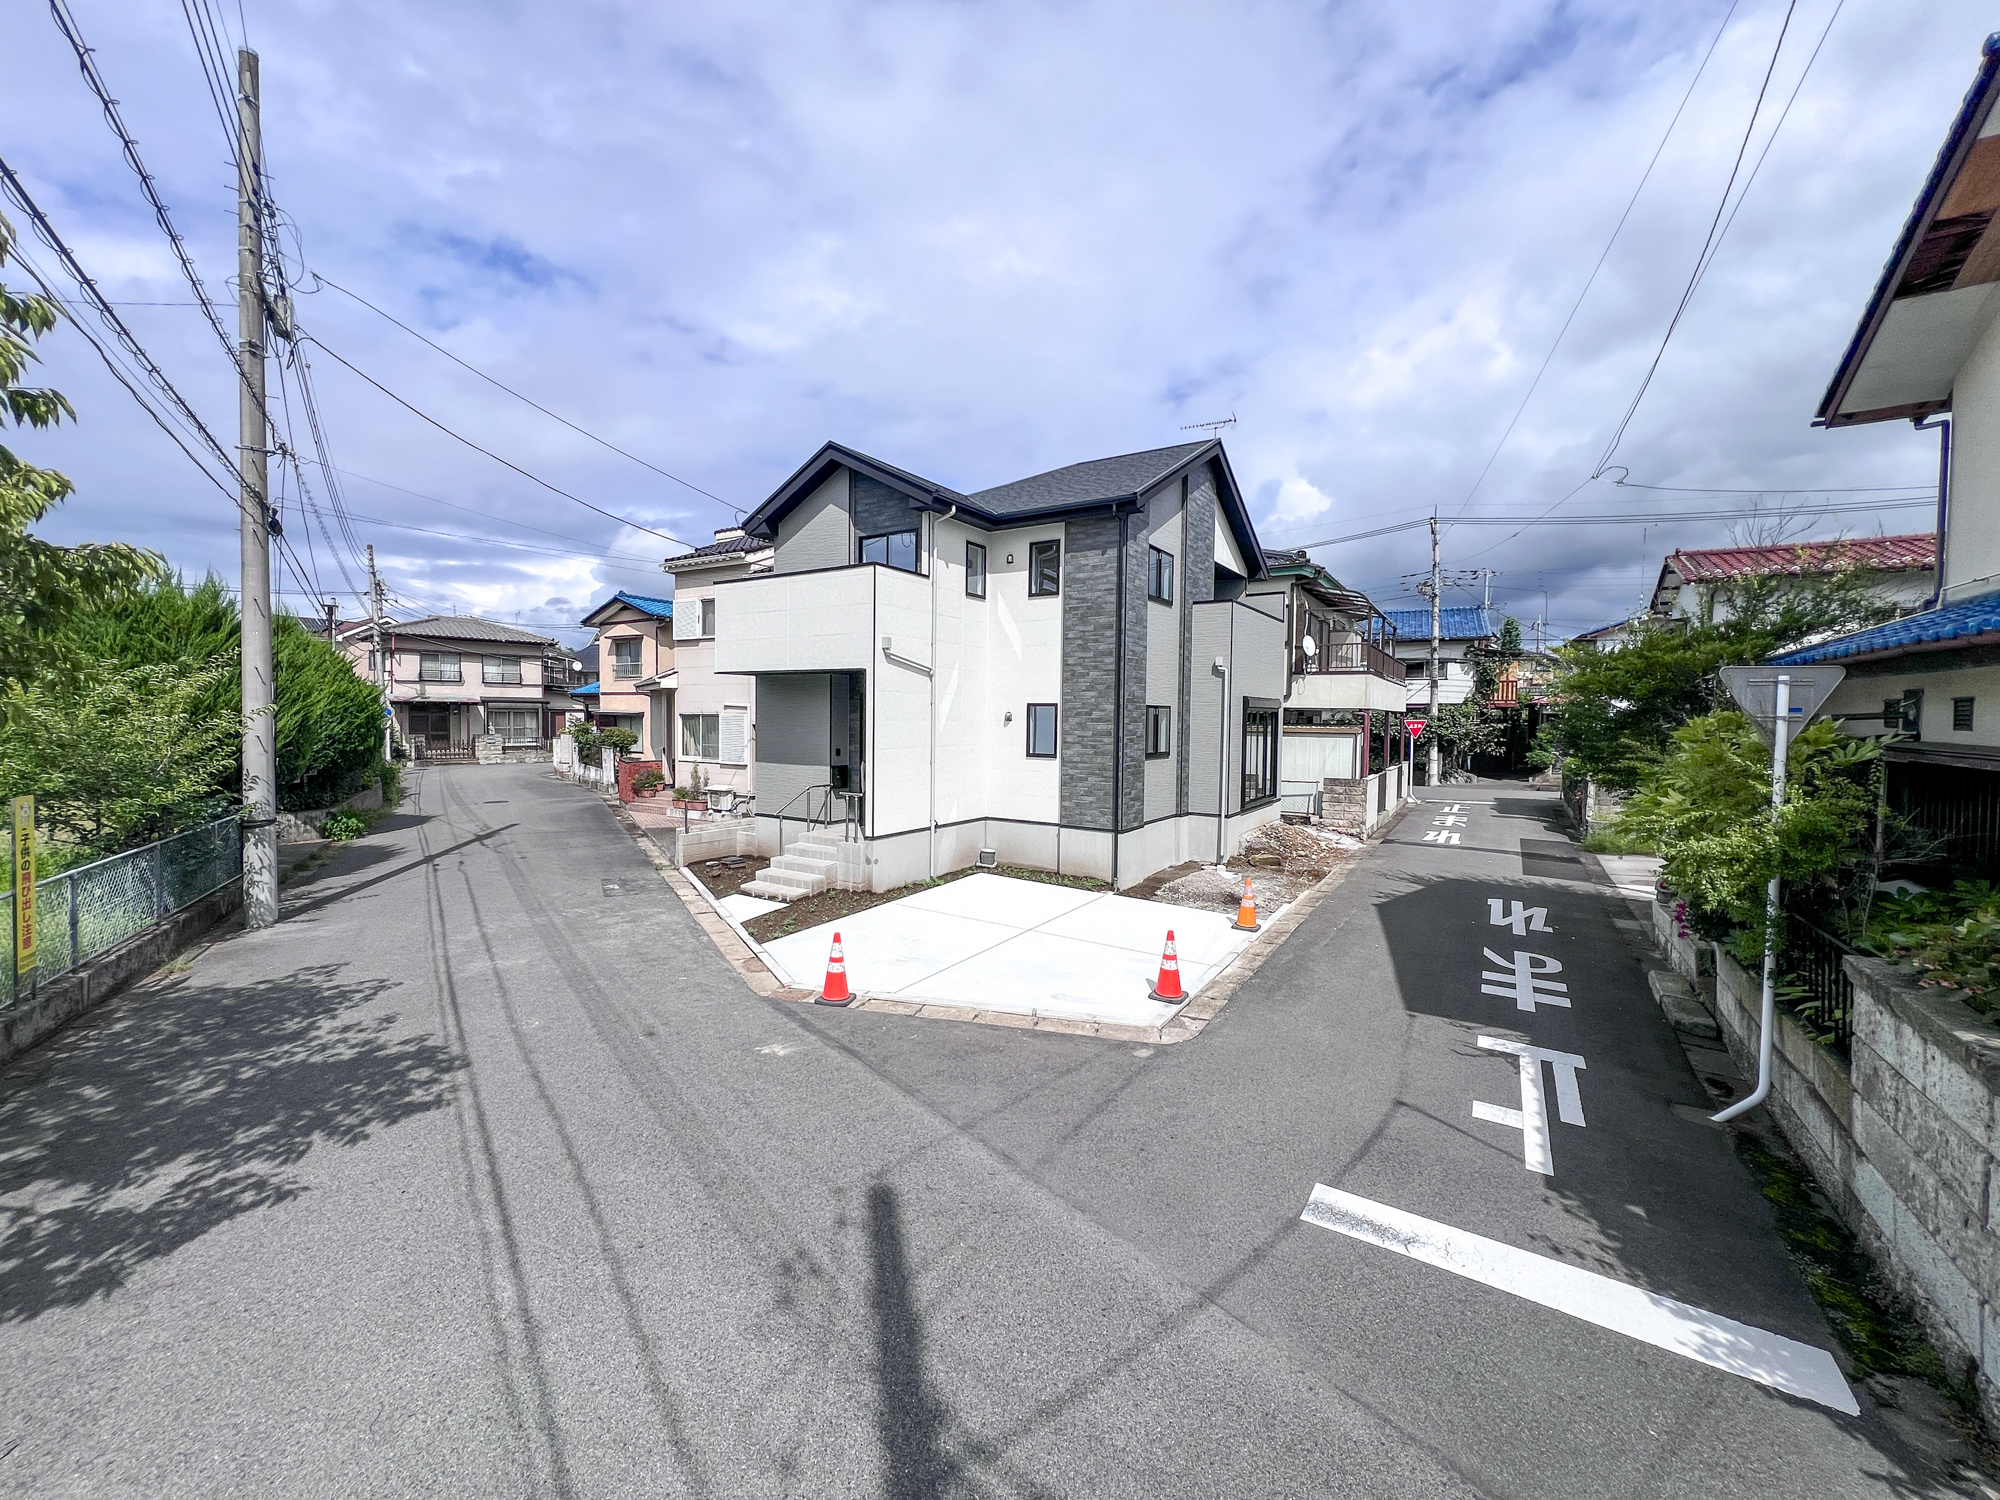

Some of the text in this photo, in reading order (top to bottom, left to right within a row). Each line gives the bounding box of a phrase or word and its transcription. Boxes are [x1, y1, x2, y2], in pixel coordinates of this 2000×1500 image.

[1421, 804, 1472, 845] 止まれ
[1471, 898, 1587, 1176] 止まれ
